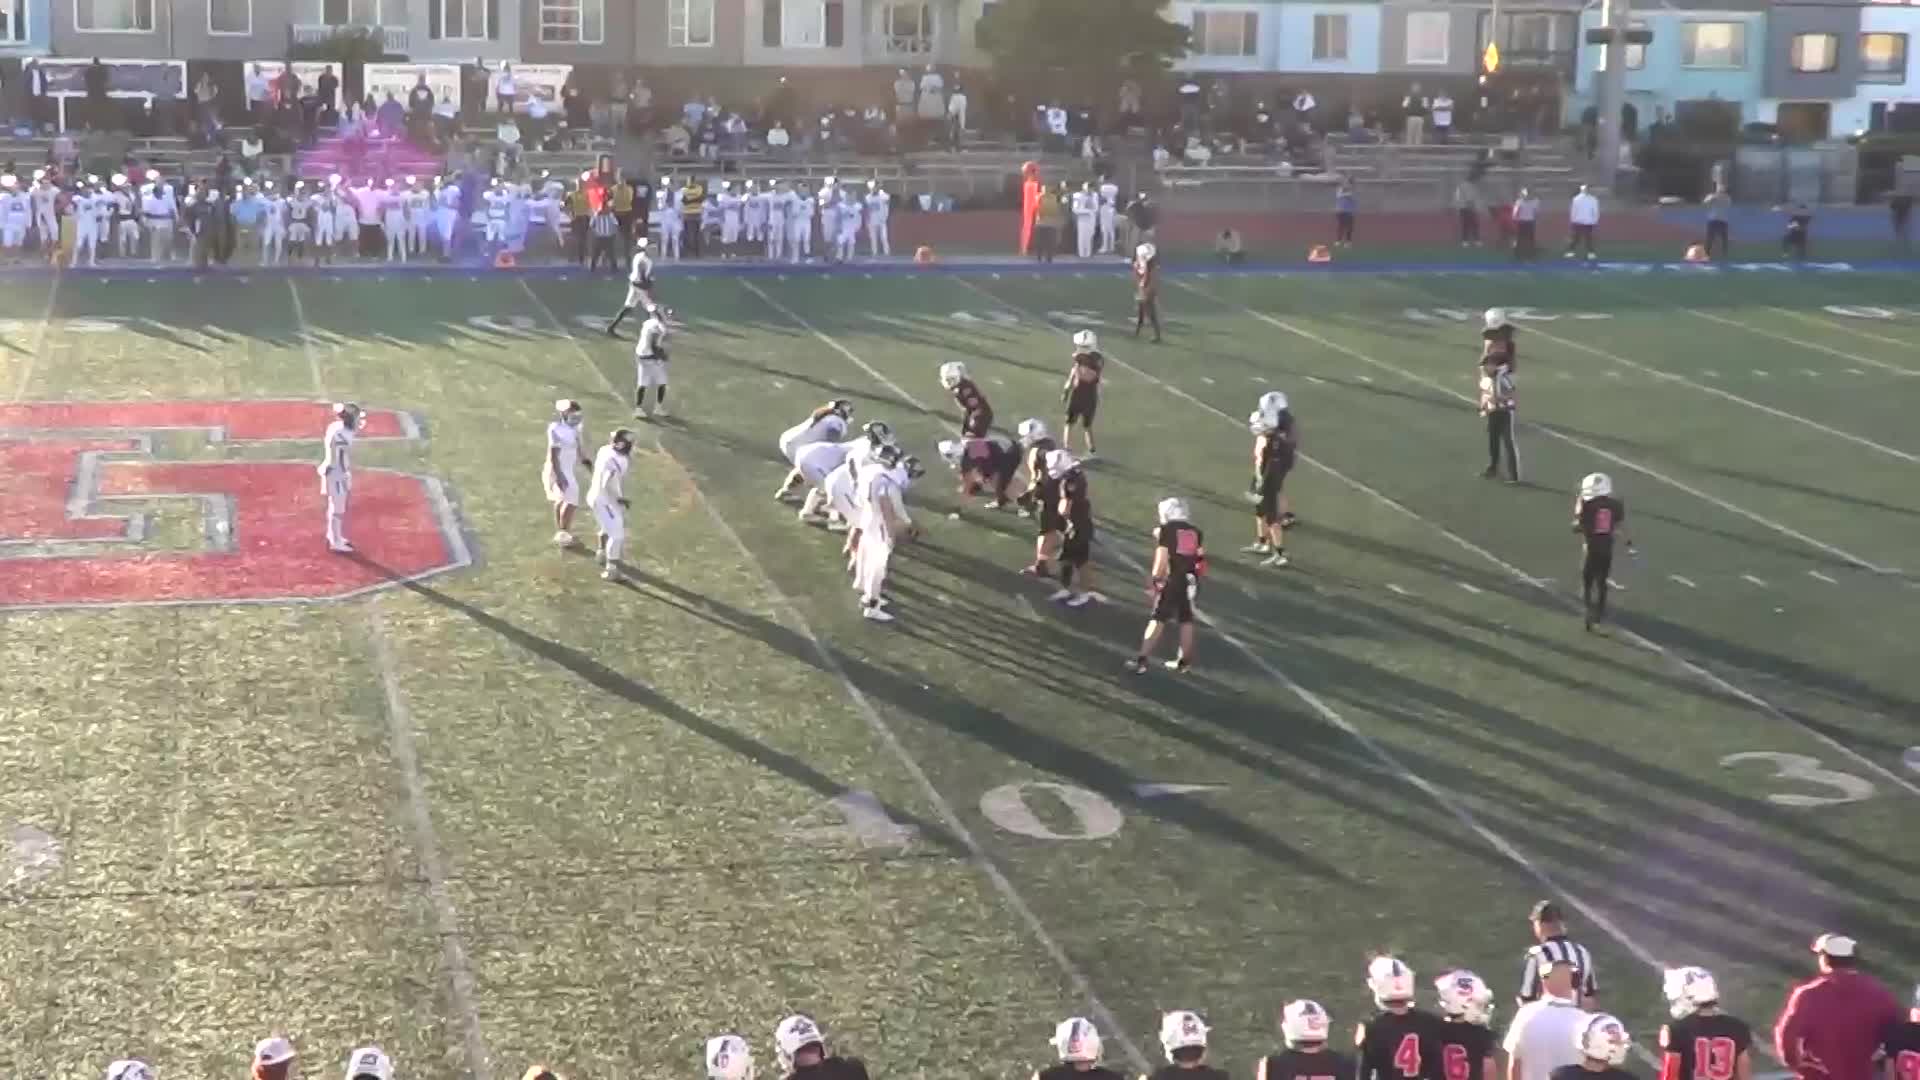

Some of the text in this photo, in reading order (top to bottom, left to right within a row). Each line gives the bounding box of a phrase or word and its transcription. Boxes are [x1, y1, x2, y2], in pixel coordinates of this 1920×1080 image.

[1719, 751, 1875, 806] 3
[979, 781, 1125, 841] 0
[1393, 1032, 1422, 1078] 4
[1442, 1044, 1470, 1080] 6
[1694, 1036, 1736, 1080] 13
